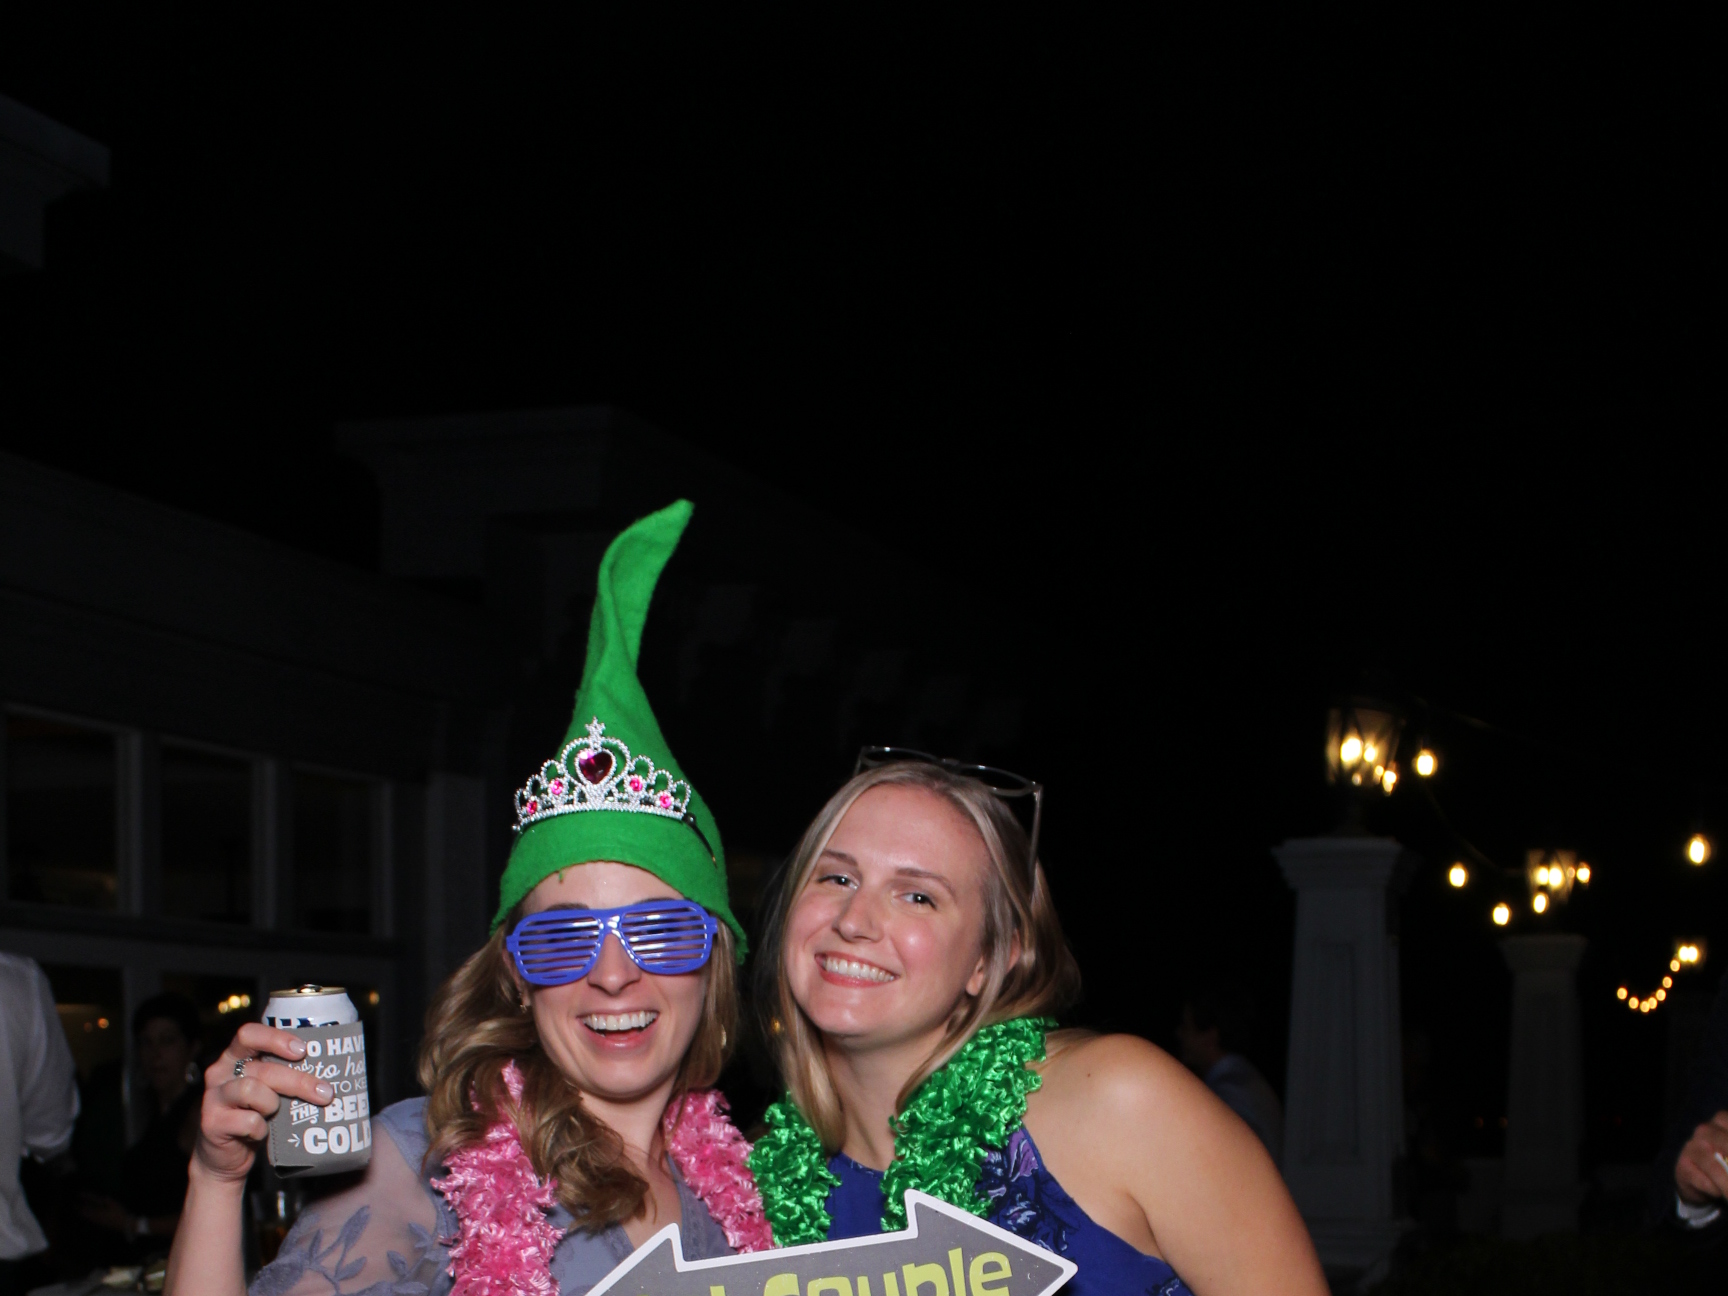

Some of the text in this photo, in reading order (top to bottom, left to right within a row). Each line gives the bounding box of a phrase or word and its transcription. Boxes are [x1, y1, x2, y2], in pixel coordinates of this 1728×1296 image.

[304, 1040, 322, 1057] O
[288, 1056, 366, 1079] nd to ho
[330, 1077, 367, 1094] TO KE
[290, 1091, 369, 1123] THE BEE
